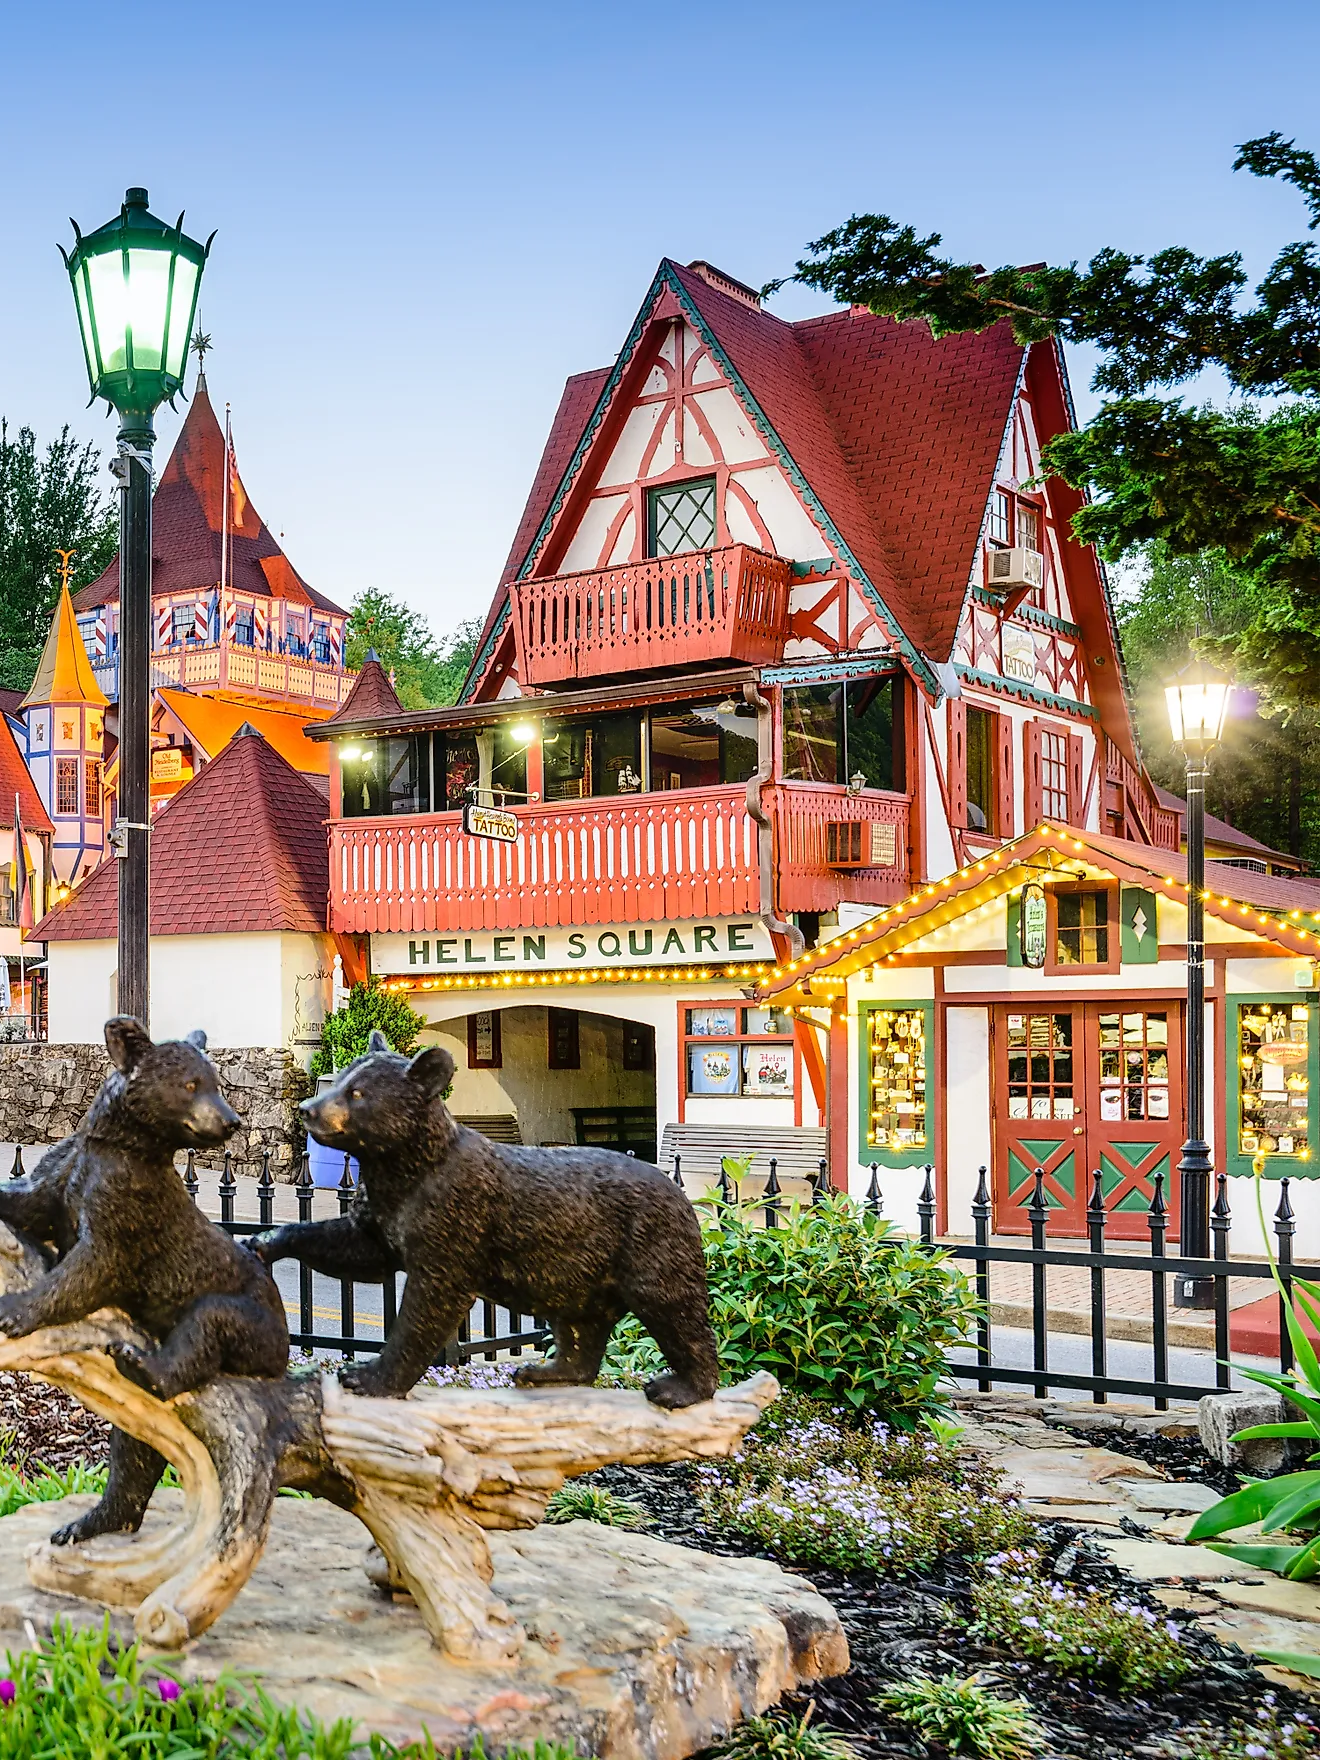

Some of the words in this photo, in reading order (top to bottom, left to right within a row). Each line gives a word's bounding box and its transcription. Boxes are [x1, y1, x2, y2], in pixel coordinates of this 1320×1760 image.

[1004, 654, 1034, 679] TATTOO
[161, 752, 172, 760] Old
[473, 818, 516, 838] TATTOO
[408, 934, 546, 965] HELEN
[567, 922, 754, 959] SQUARE
[759, 1053, 786, 1063] Helen
